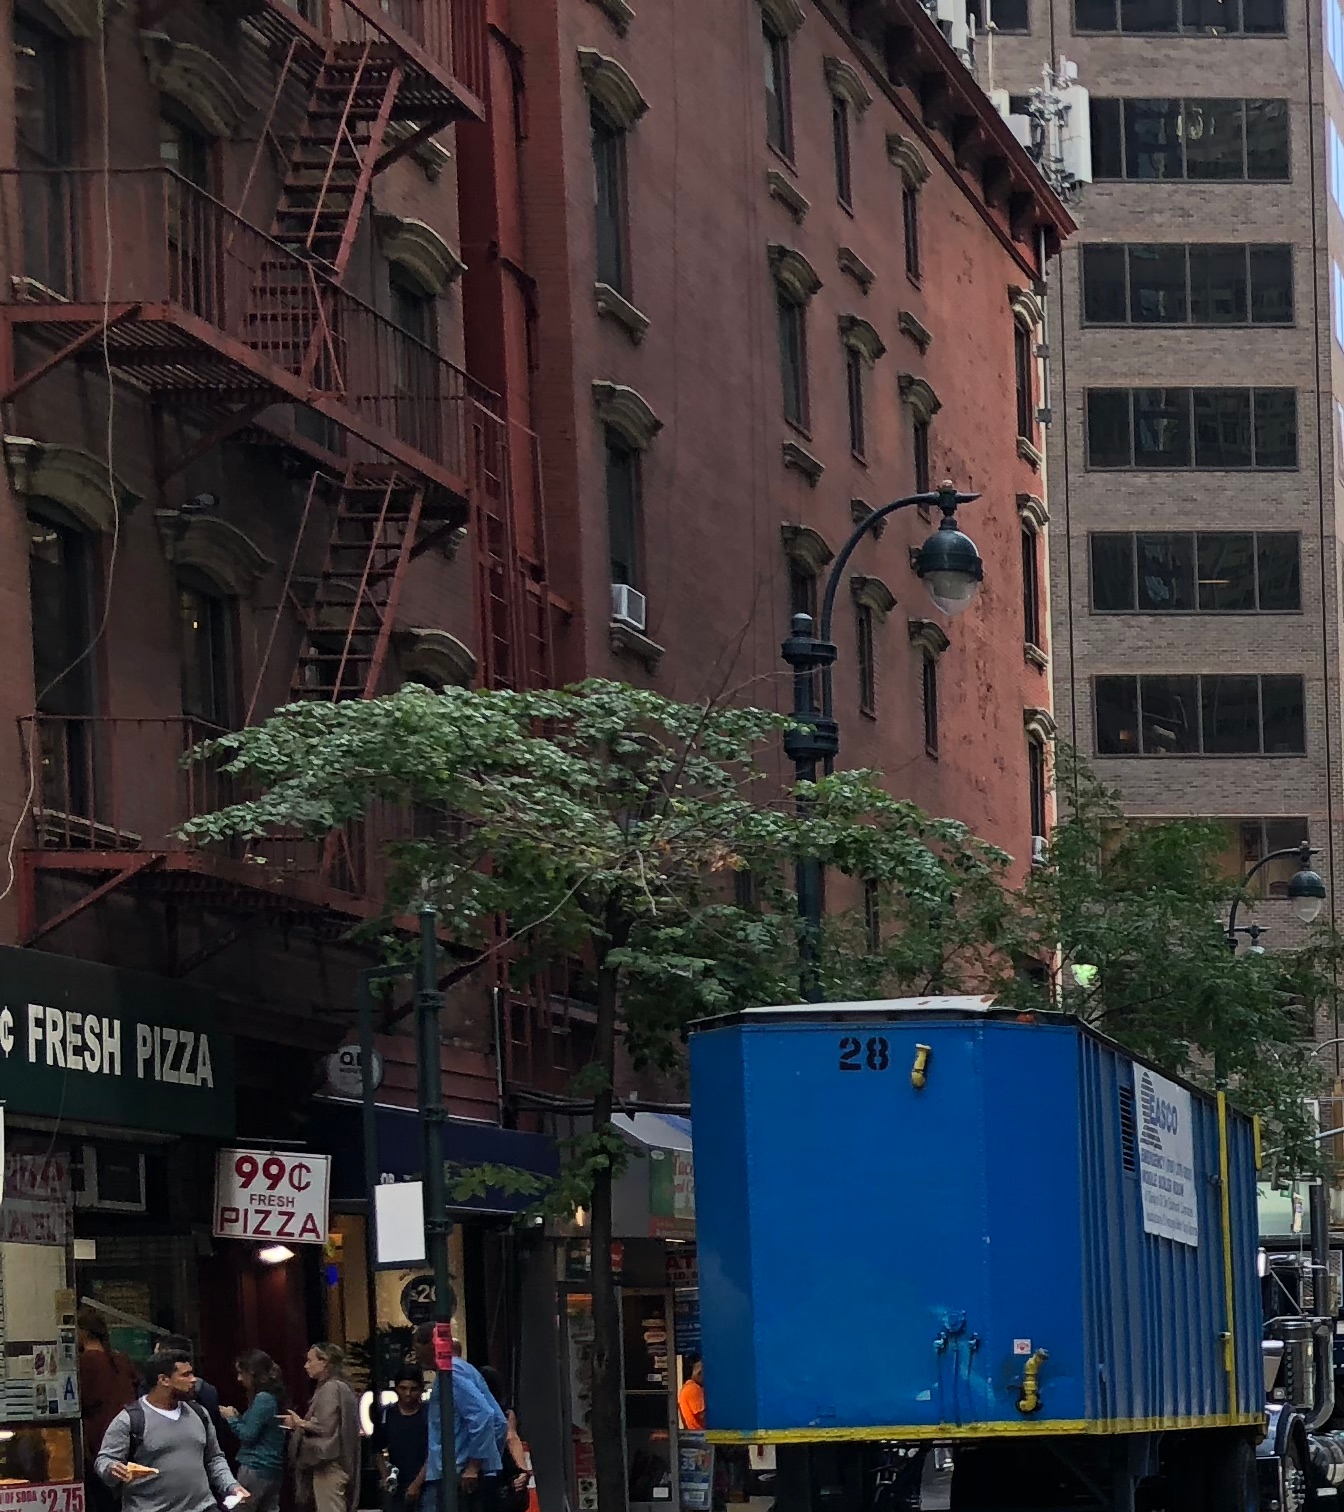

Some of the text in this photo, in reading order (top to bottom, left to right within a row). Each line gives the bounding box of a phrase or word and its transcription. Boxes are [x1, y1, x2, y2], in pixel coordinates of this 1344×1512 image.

[28, 1003, 122, 1077] FRESH
[136, 1022, 214, 1089] PIZZA
[839, 1036, 889, 1071] 28
[1149, 1096, 1178, 1136] EASCO
[234, 1155, 313, 1193] 99¢
[249, 1193, 296, 1209] FRESH
[219, 1206, 322, 1240] PIZZA
